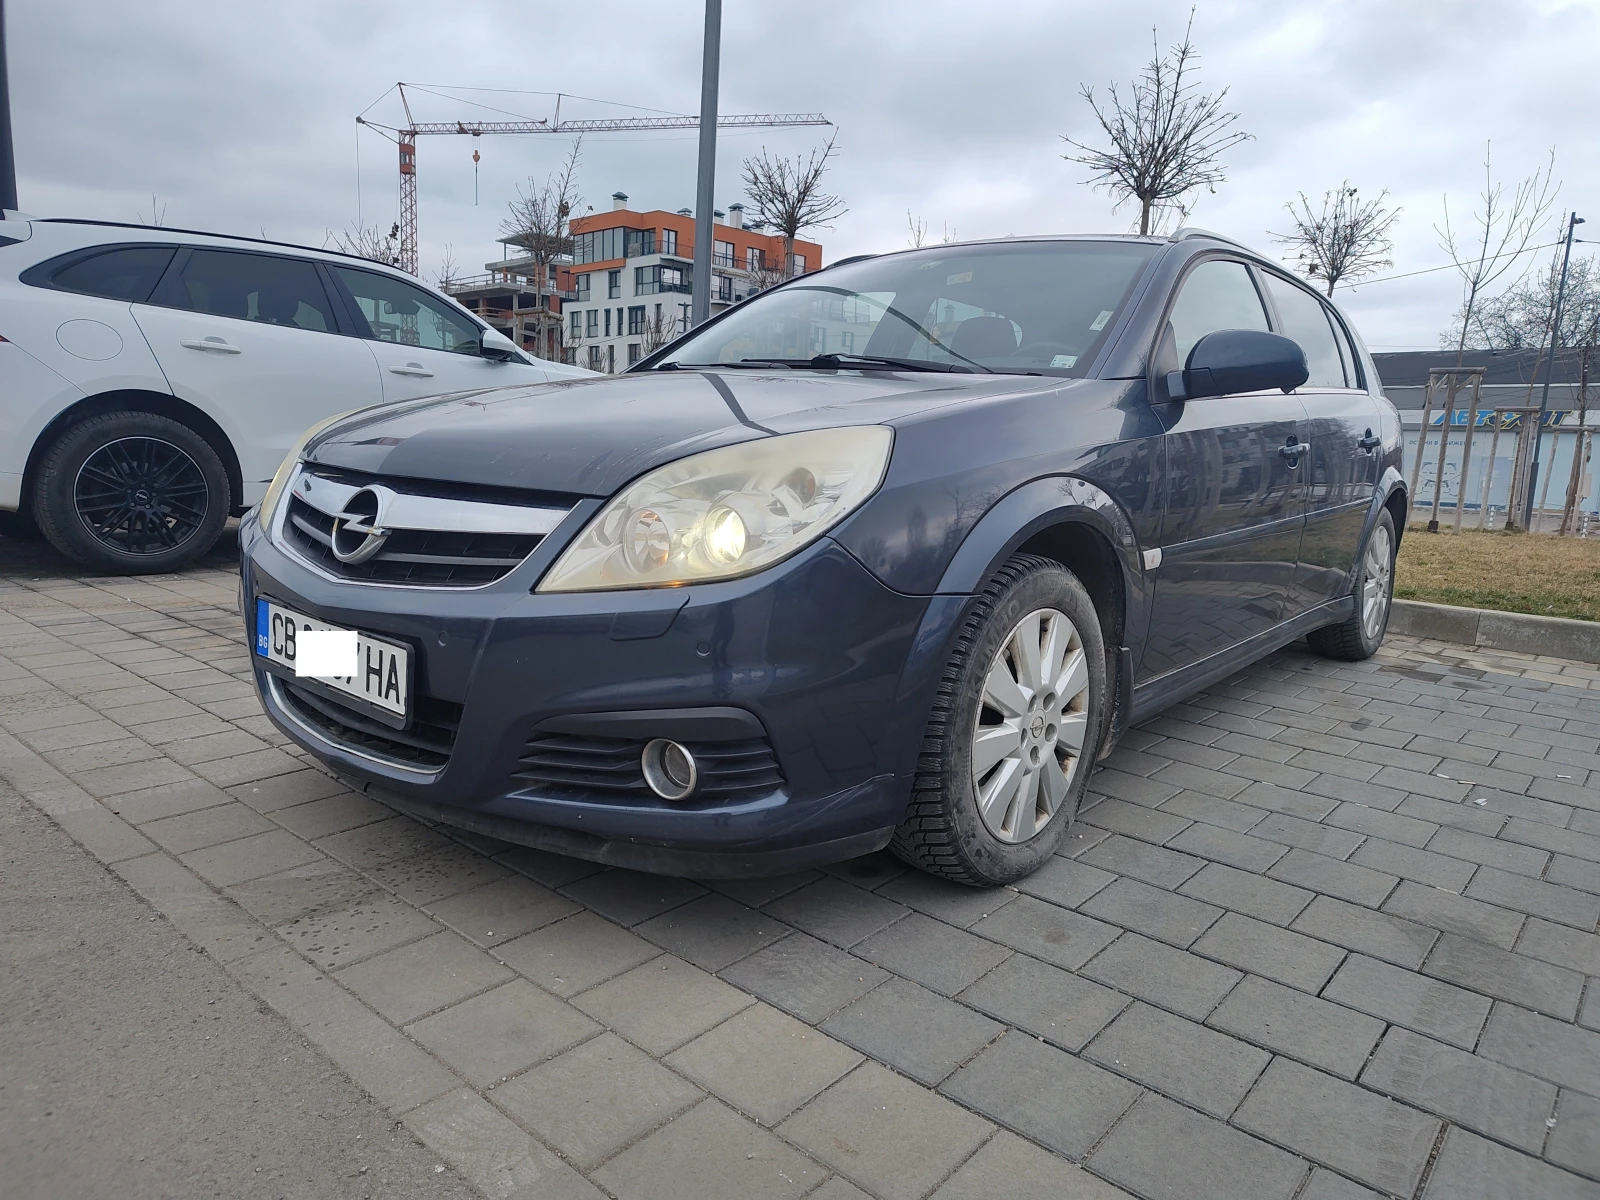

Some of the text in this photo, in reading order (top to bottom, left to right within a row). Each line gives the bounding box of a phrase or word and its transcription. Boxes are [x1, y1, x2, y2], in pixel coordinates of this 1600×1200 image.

[258, 634, 268, 649] BG
[272, 612, 296, 661] CB
[365, 645, 401, 705] HA
[968, 599, 1020, 699] KUMHO
